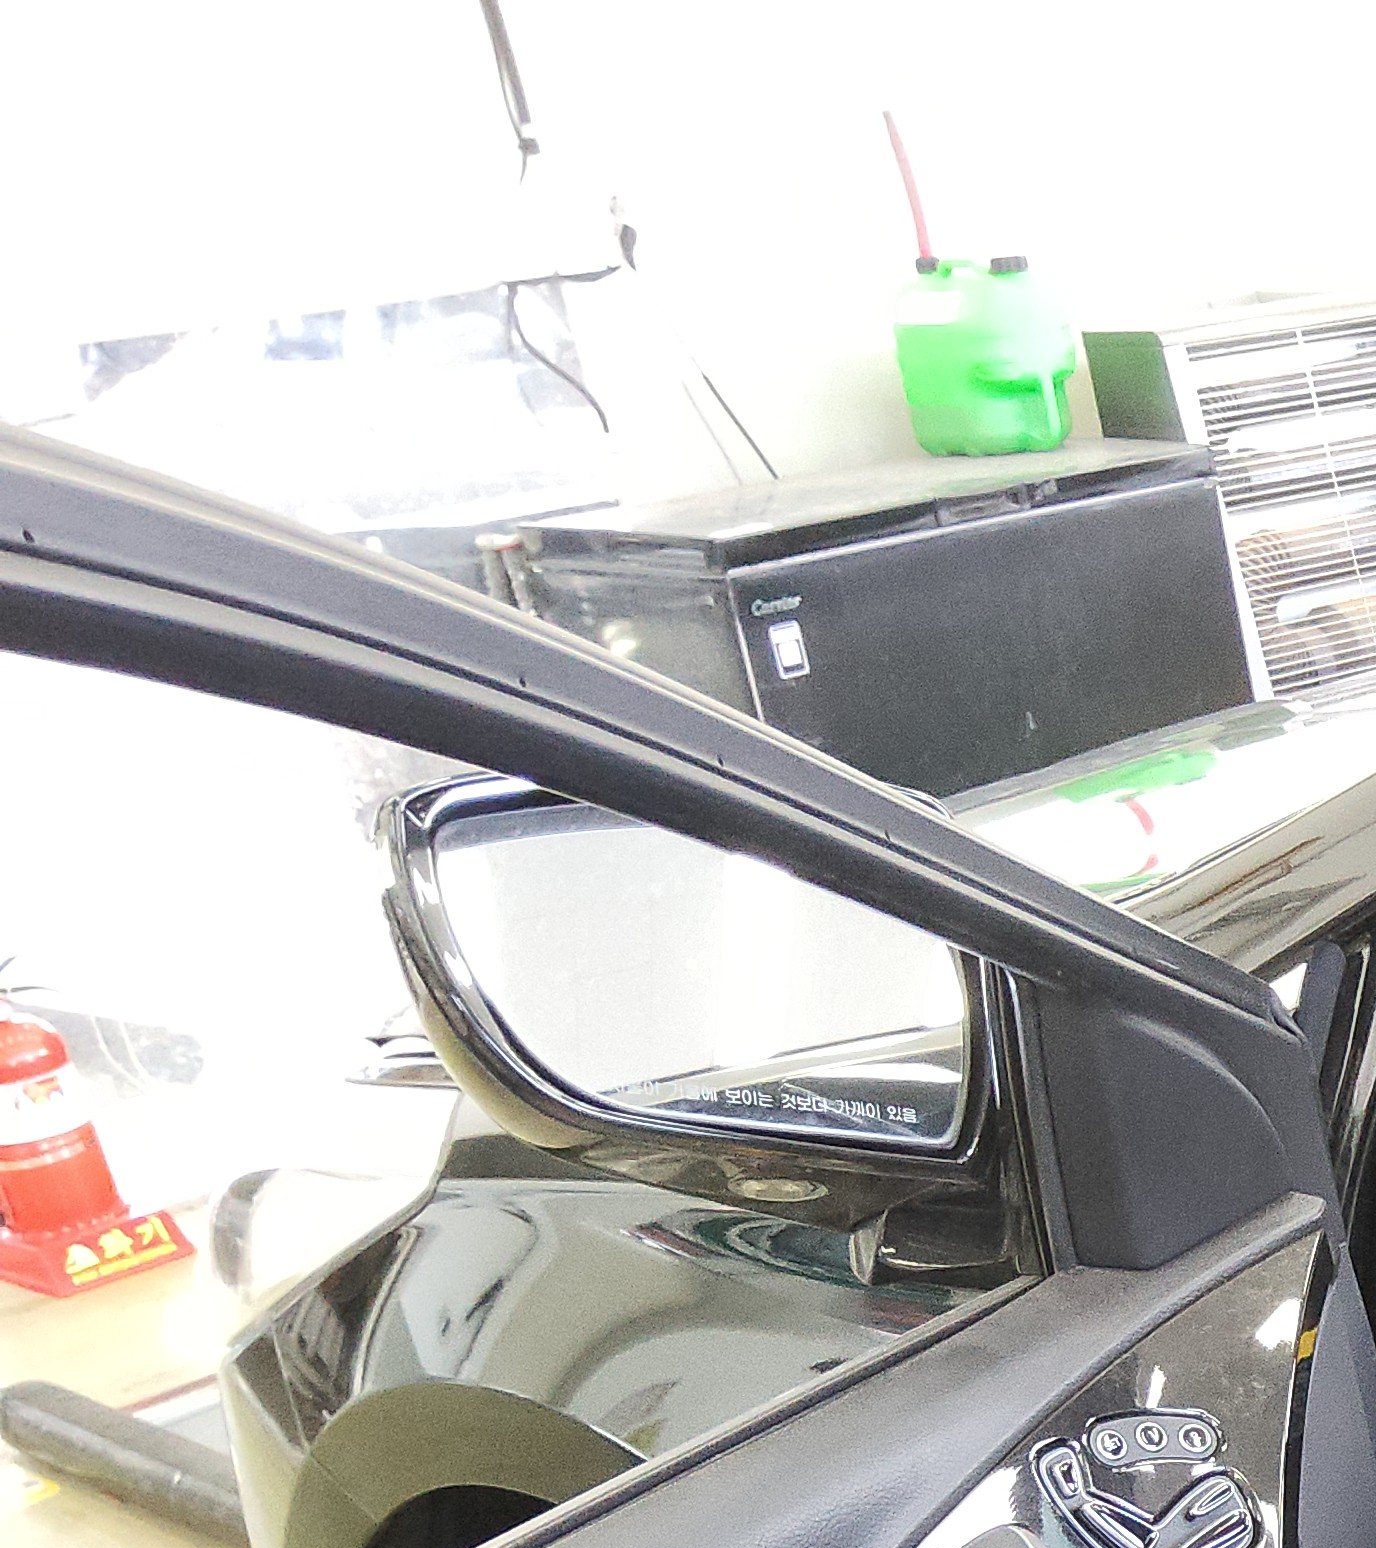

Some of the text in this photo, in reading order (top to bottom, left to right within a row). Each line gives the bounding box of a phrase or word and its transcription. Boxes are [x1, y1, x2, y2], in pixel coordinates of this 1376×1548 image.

[725, 1088, 775, 1108] 보이는
[780, 1093, 828, 1114] 것보다
[834, 1099, 883, 1121] 가까이
[886, 1105, 918, 1124] 있음
